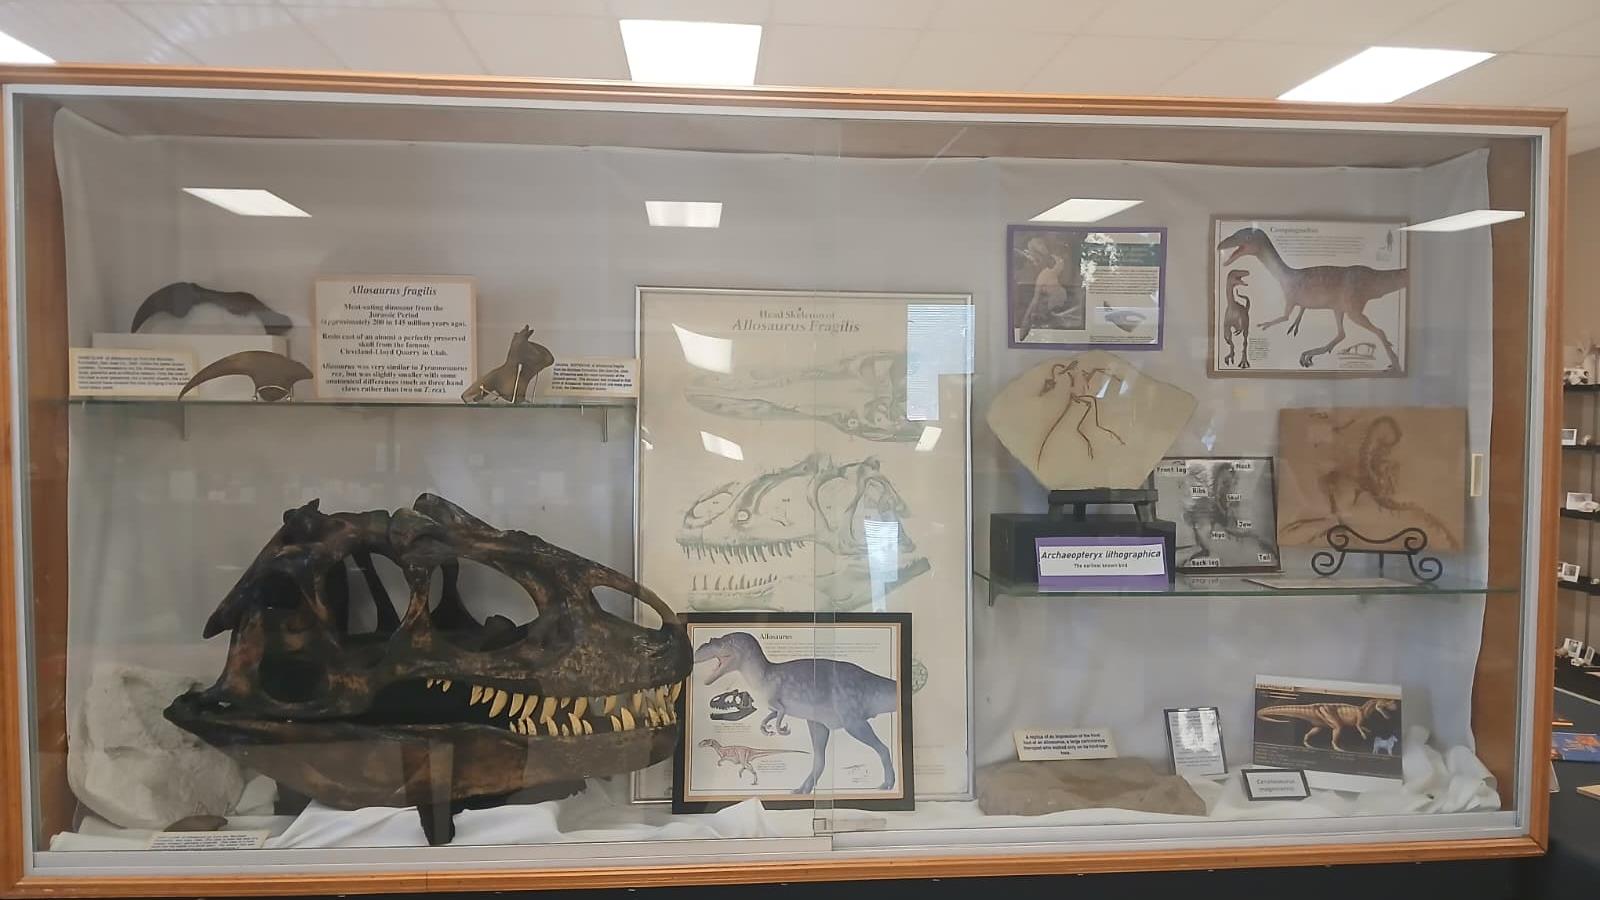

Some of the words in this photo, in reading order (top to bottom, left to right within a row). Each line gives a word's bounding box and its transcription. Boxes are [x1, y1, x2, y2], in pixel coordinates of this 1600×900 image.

[349, 285, 401, 296] Allosaurus
[401, 286, 437, 297] fragilis
[344, 303, 384, 311] Meat-eating
[732, 319, 806, 331] Allosaurus
[809, 320, 861, 333] Fragilis
[372, 371, 395, 379] slightly
[1176, 466, 1186, 474] leg
[1041, 550, 1103, 561] Archaeopteryx
[1105, 549, 1161, 560] lithographica
